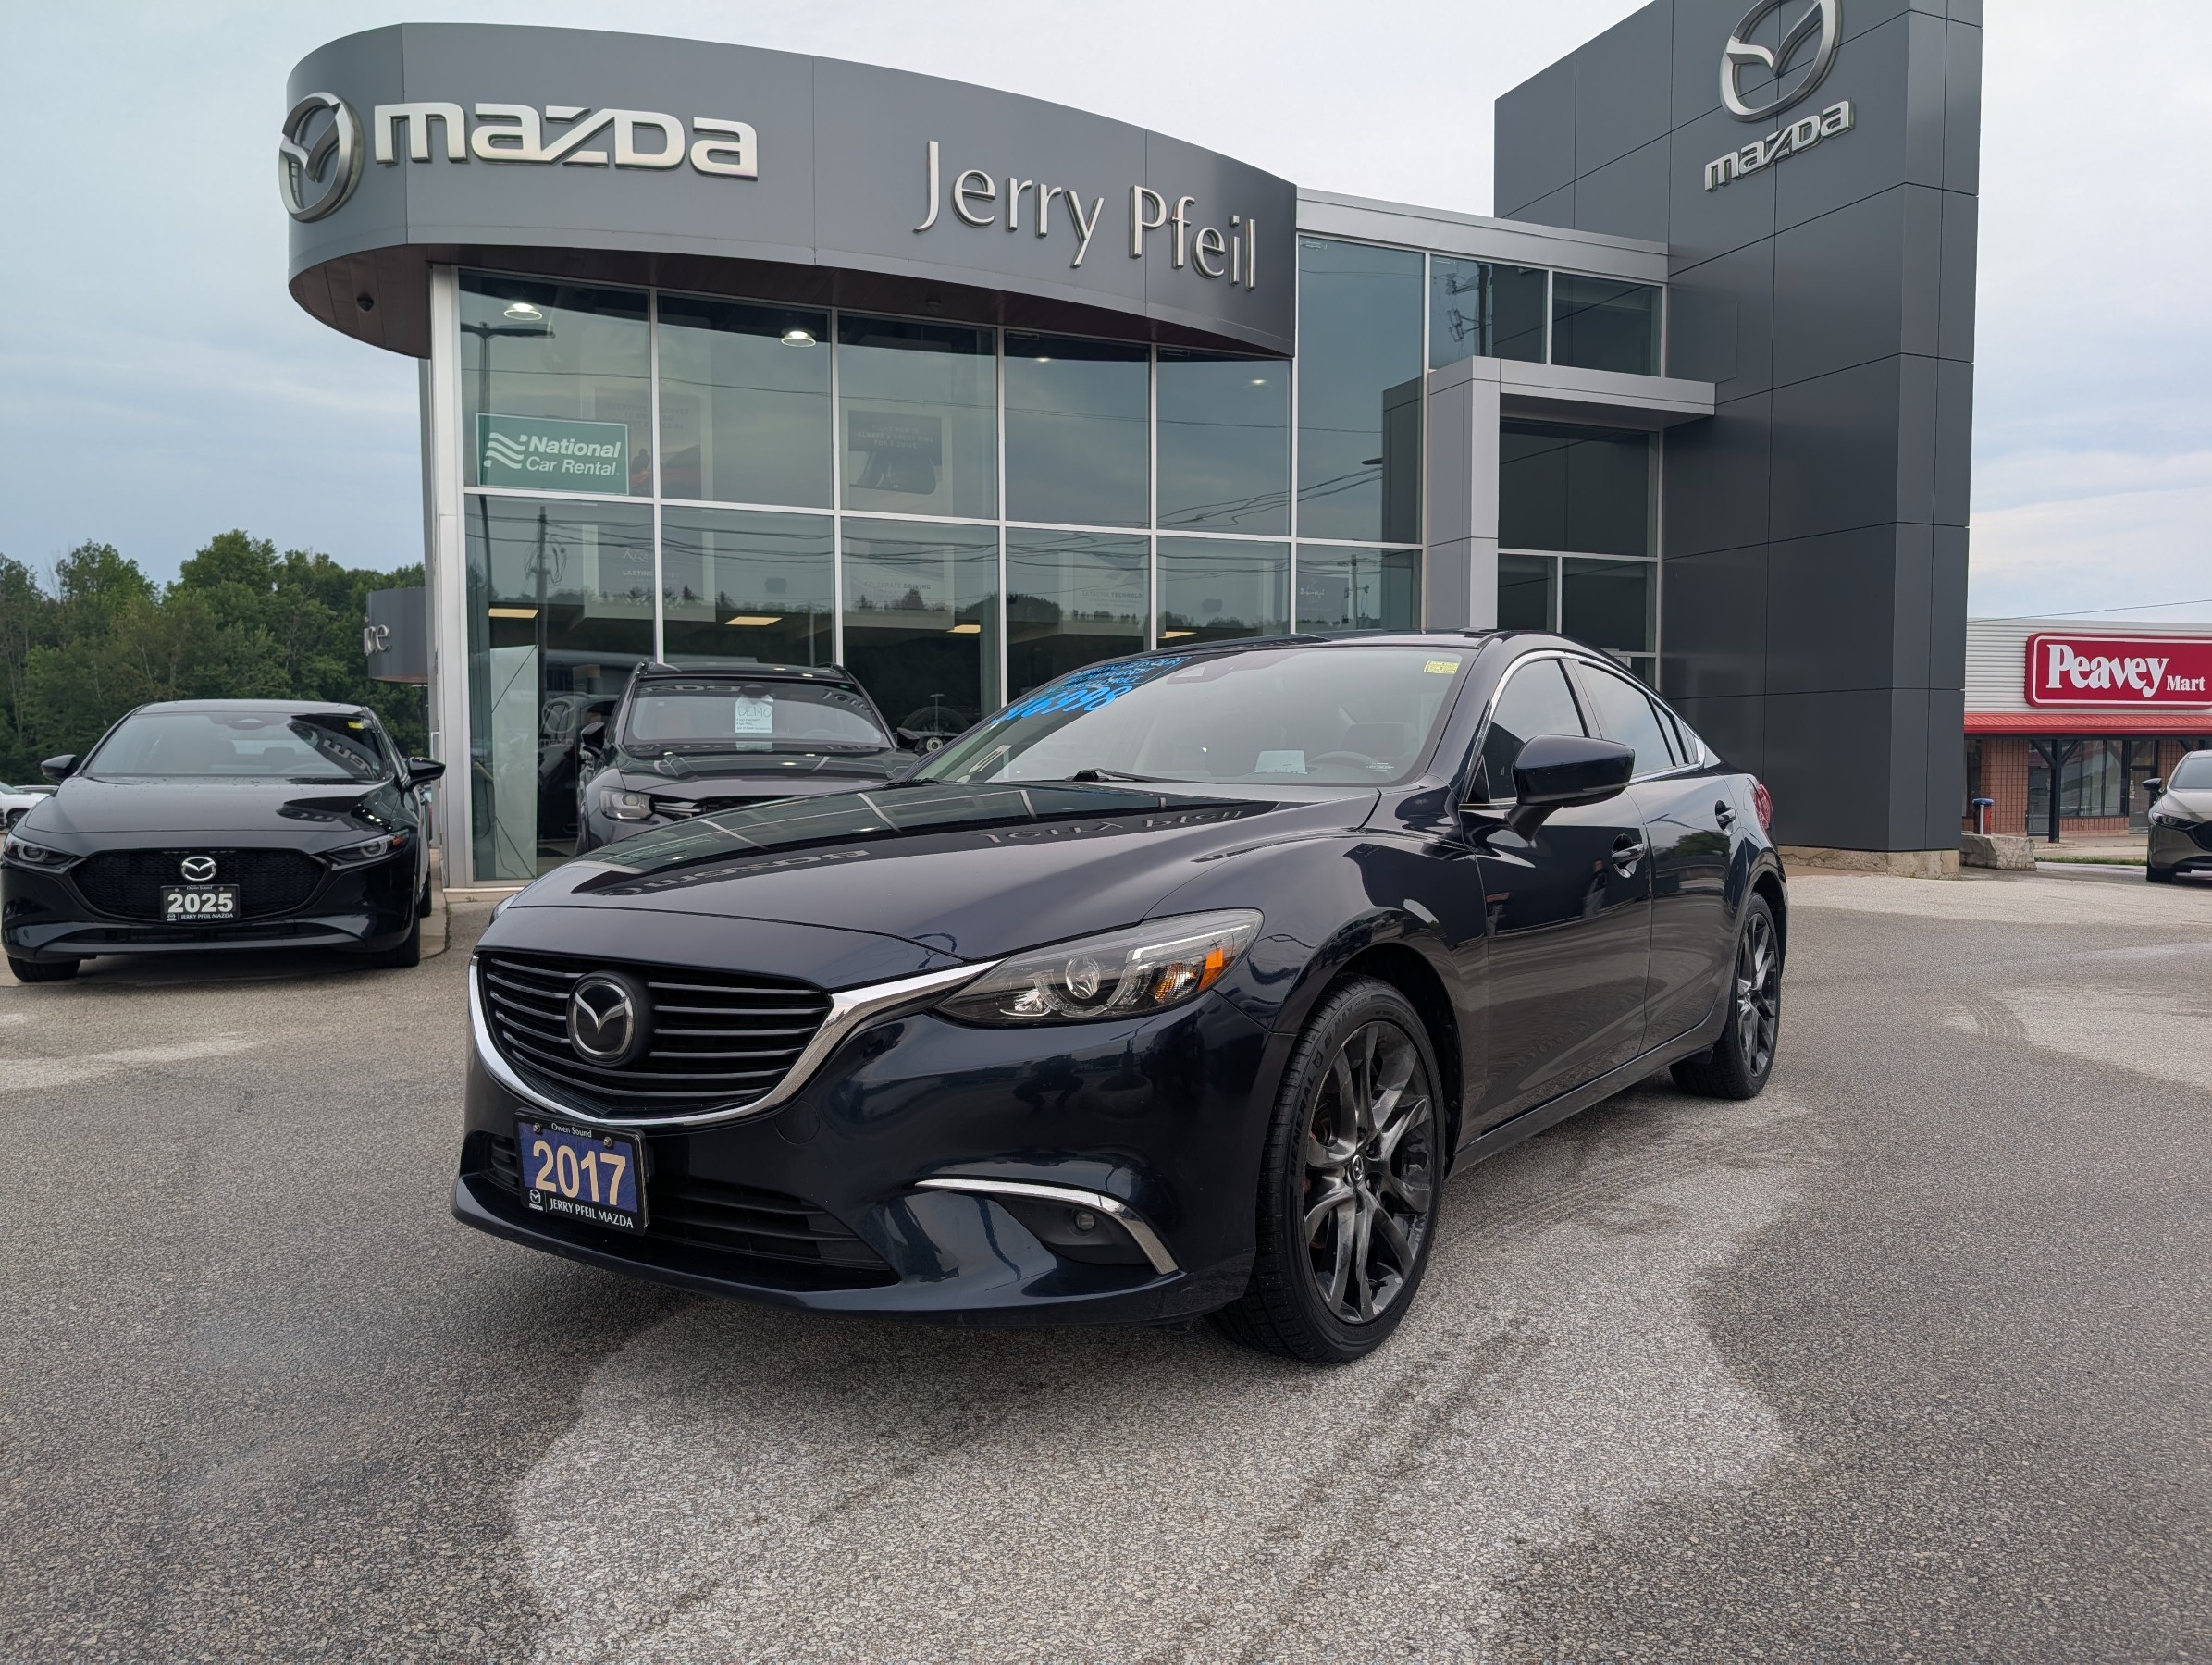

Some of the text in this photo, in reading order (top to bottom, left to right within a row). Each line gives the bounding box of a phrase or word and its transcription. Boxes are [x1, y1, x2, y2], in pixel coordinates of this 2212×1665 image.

[374, 102, 759, 182] mazda
[1704, 100, 1853, 192] mazda
[912, 140, 1256, 291] Jerry Pfeil
[528, 435, 622, 458] National
[526, 456, 617, 475] Car Rental
[2045, 644, 2169, 697] Peavey
[2166, 675, 2206, 692] Mart
[737, 705, 772, 718] DEMO
[167, 893, 233, 913] 2025
[551, 1122, 592, 1138] Owen Sound
[533, 1139, 626, 1206] 2017
[550, 1197, 634, 1229] JERRY PFEIL MAZDA
